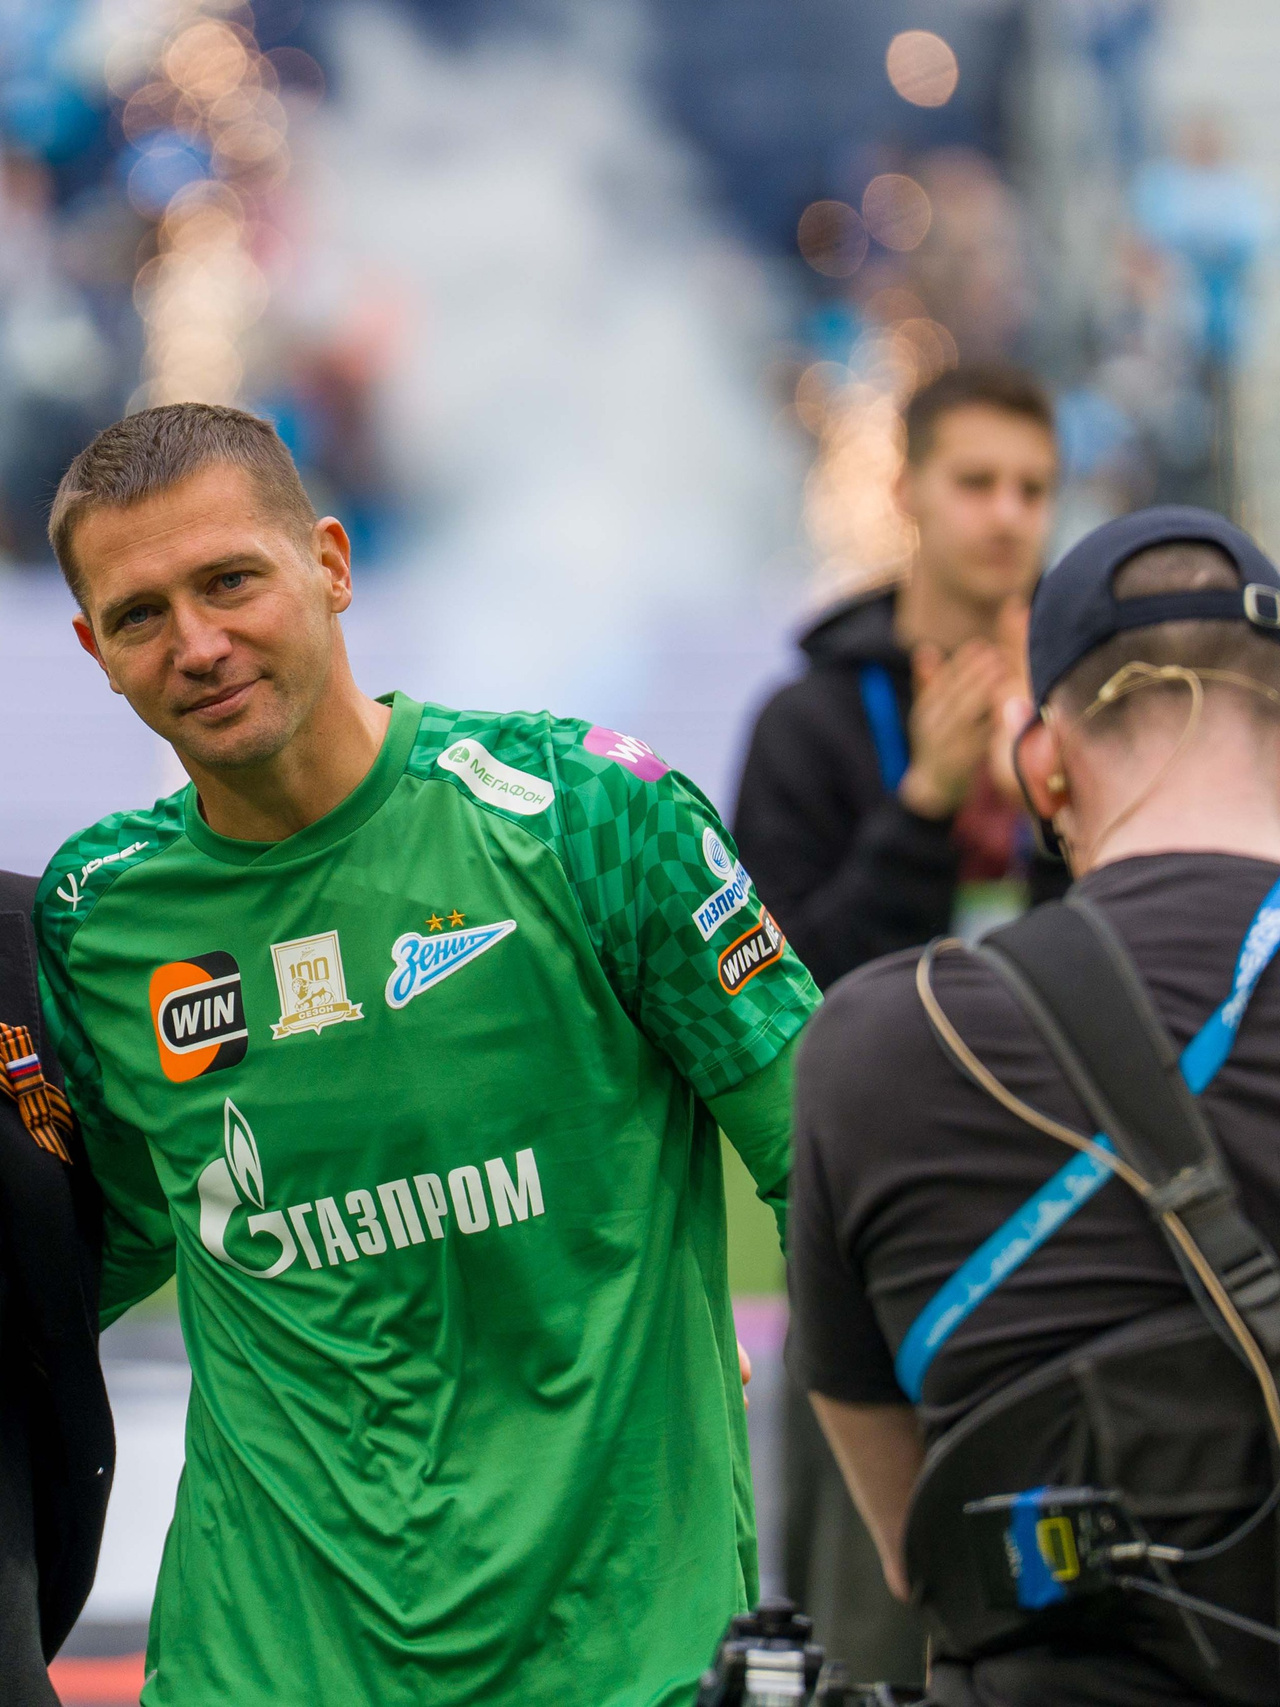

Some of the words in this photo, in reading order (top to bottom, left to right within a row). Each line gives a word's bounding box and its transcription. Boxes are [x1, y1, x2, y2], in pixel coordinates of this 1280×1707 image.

[470, 758, 546, 805] МЕГАФОН
[288, 957, 330, 981] 100
[171, 991, 235, 1039] WIN
[298, 1005, 334, 1019] СЕЗОН
[287, 1147, 545, 1270] ГАЗПРОМ
